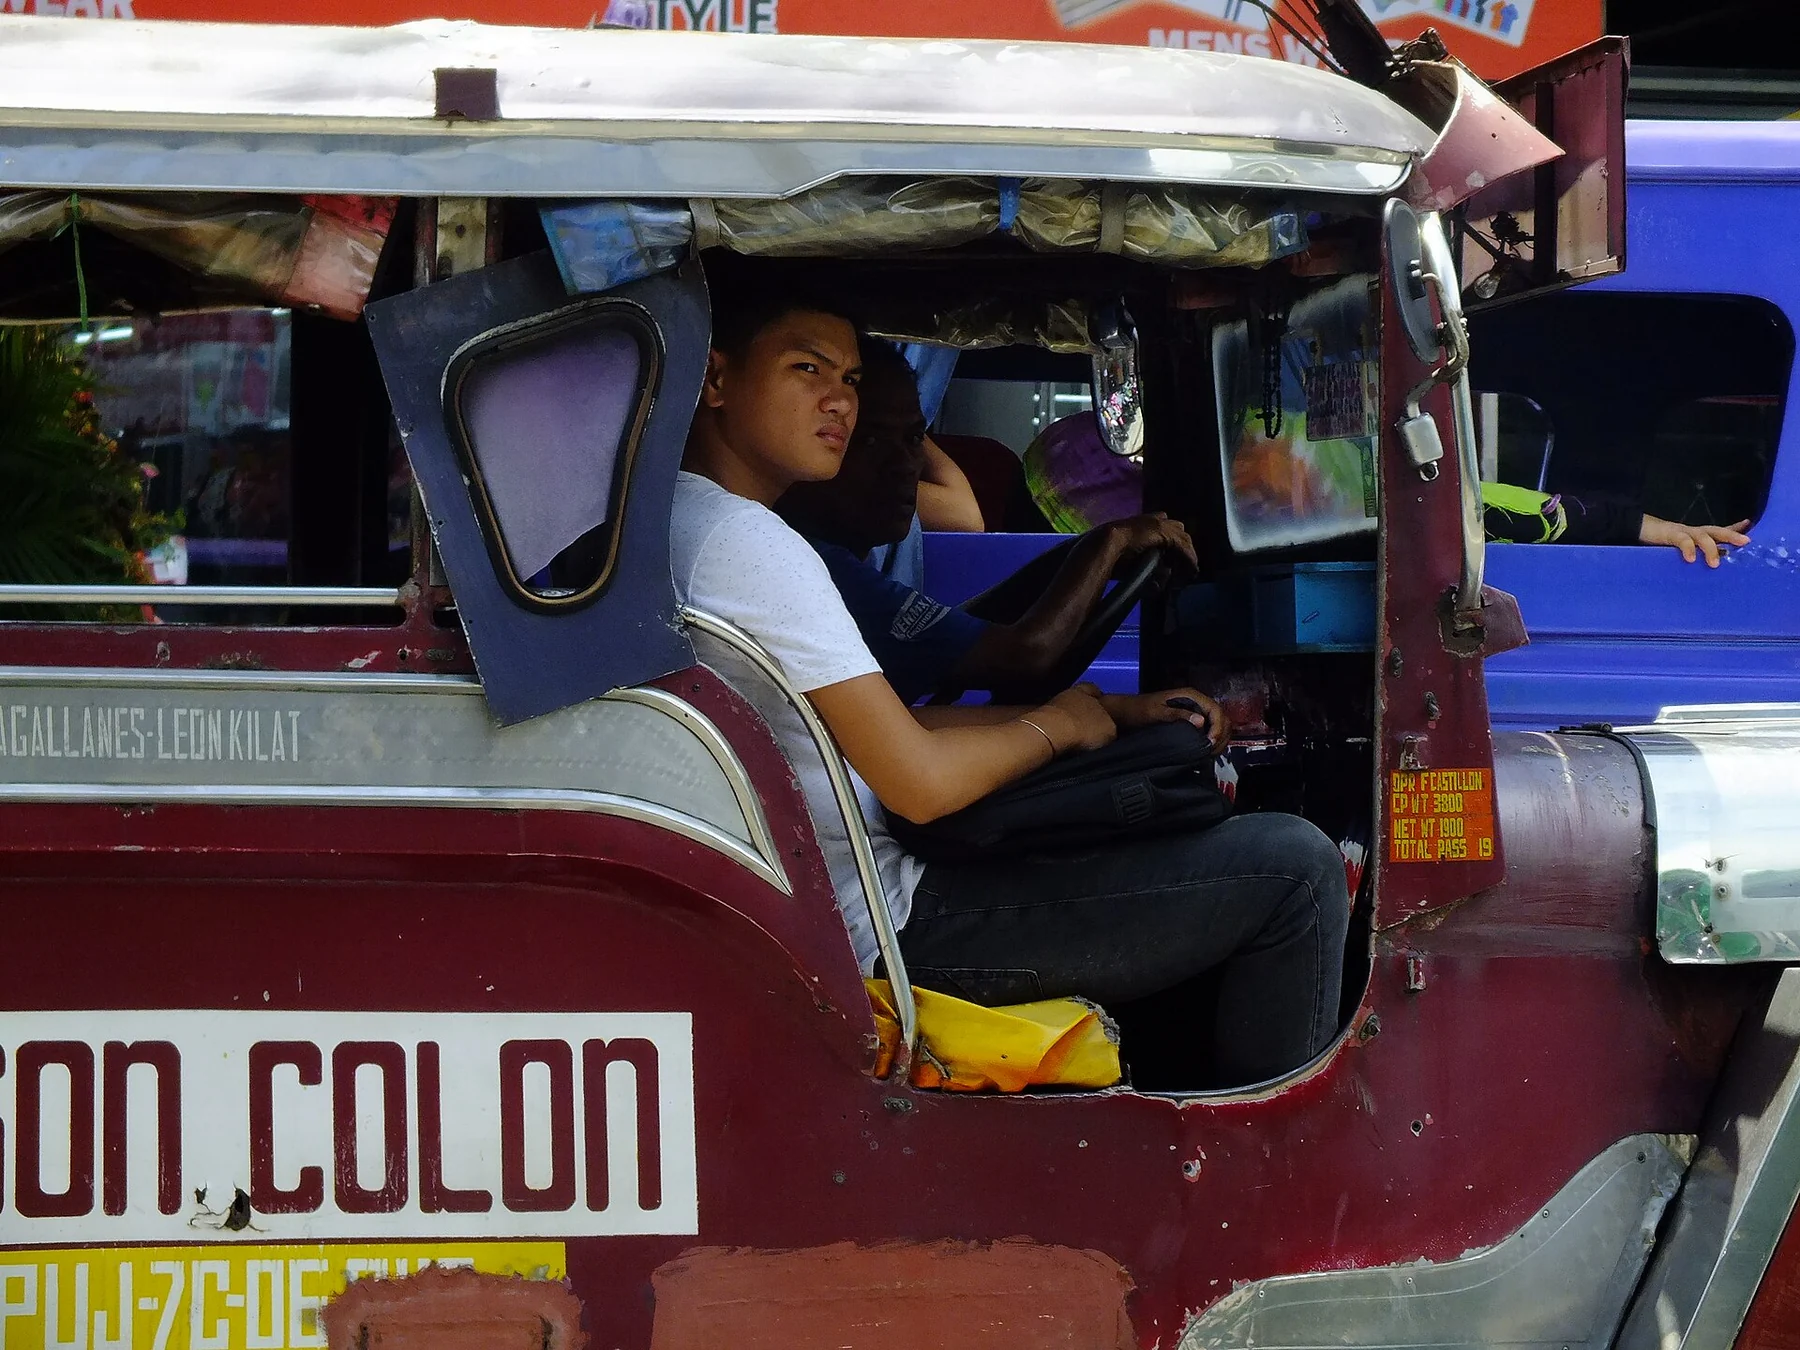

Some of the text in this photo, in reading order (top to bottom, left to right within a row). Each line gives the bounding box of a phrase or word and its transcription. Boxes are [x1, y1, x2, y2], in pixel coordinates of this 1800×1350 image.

[229, 709, 301, 762] KILAT
[1433, 792, 1463, 813] 3800
[1393, 818, 1417, 839] NET
[1439, 817, 1464, 838] 1900
[1394, 837, 1492, 859] TOTAL PASS 19
